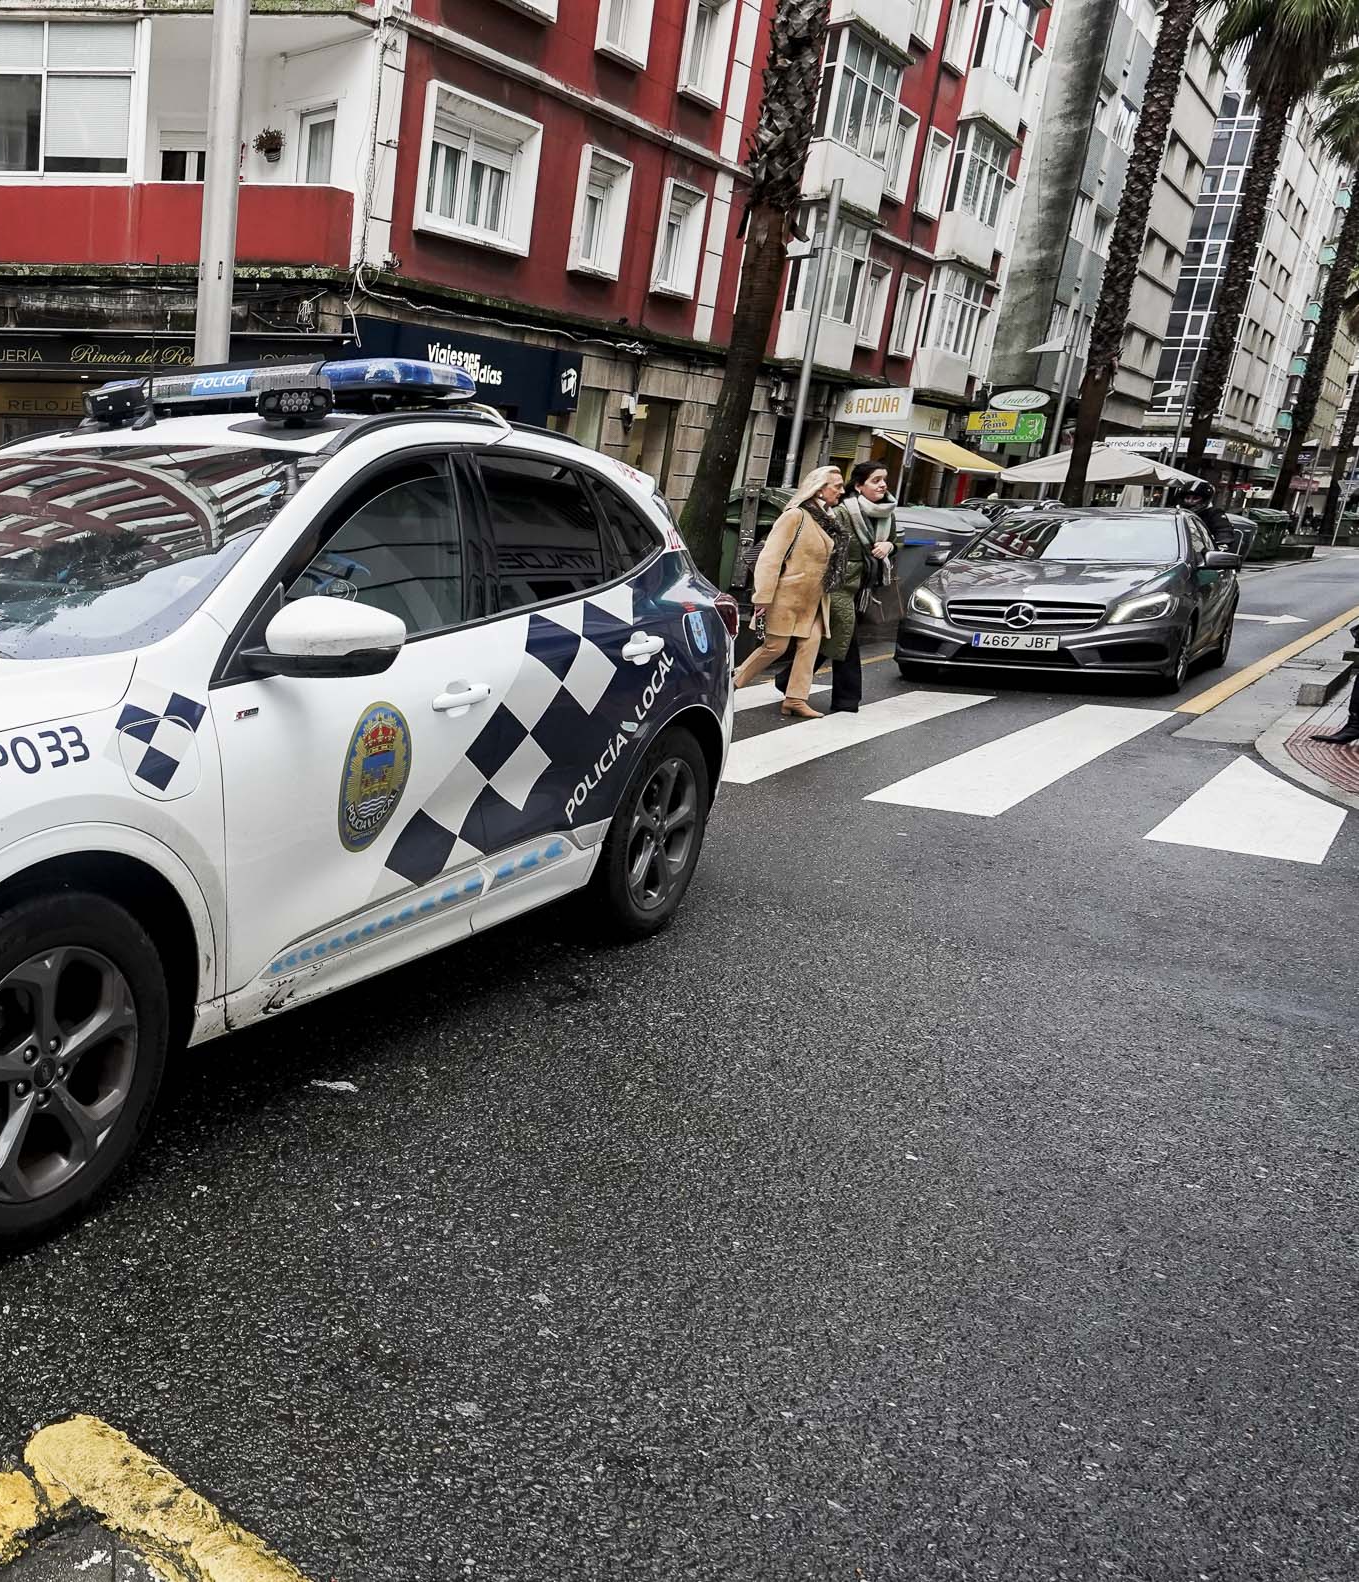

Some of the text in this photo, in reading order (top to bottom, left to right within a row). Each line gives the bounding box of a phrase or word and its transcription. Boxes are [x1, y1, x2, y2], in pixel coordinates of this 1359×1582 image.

[70, 343, 133, 364] Rincón
[134, 349, 160, 364] del
[427, 342, 464, 367] Viajes
[479, 364, 503, 386] días
[193, 371, 249, 389] POLICÍA
[6, 399, 84, 413] RELOJE
[855, 394, 900, 414] ACUÑA
[1105, 439, 1186, 449] orreduría de segos
[983, 634, 1055, 649] 4667 JBF
[564, 651, 675, 825] POLICÍA LOCAL
[372, 790, 398, 824] LOCAL
